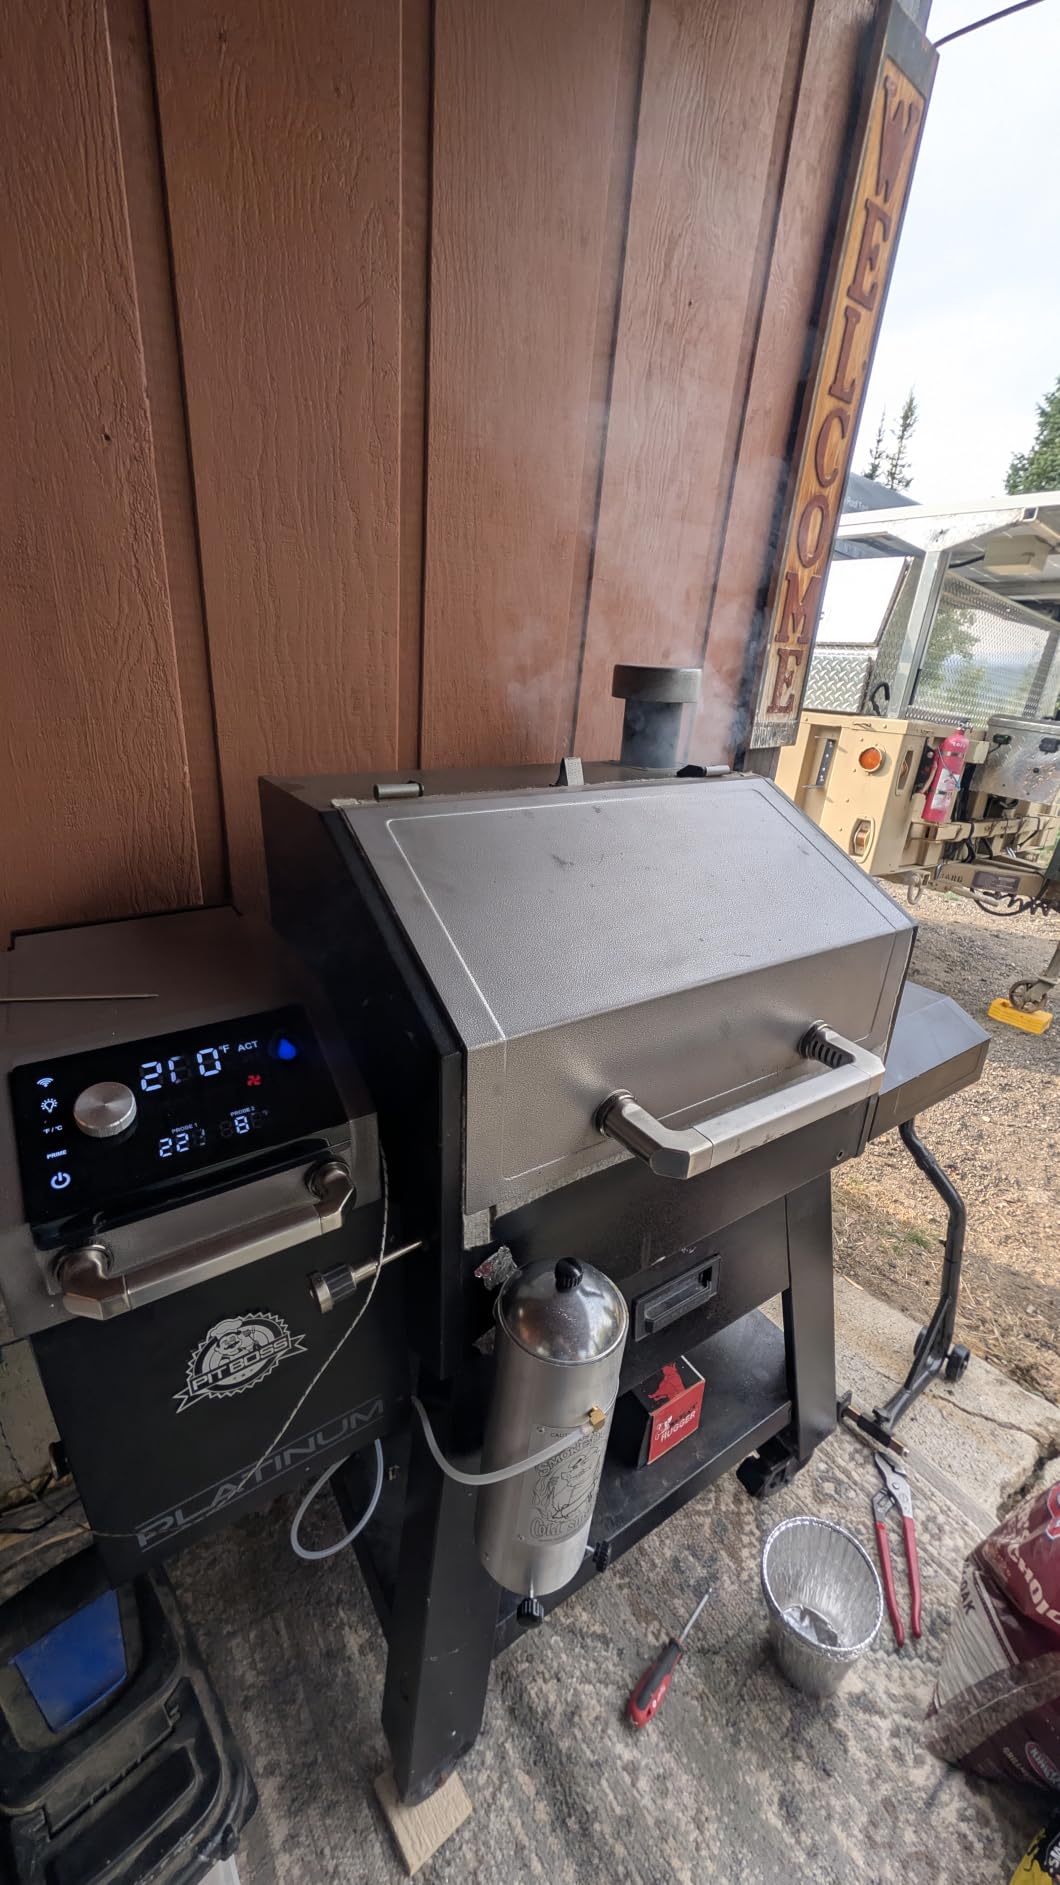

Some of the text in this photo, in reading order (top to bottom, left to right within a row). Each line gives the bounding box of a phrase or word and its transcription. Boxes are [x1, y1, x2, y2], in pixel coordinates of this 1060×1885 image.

[766, 74, 920, 715] WELCOME
[237, 1040, 259, 1052] ACT
[230, 1107, 251, 1117] PROBE
[171, 1123, 193, 1134] PROBE
[46, 1149, 67, 1160] PRIME
[192, 1337, 288, 1391] PIT BOSS
[660, 1410, 696, 1443] HUGGER
[136, 1397, 384, 1548] PLATINUM
